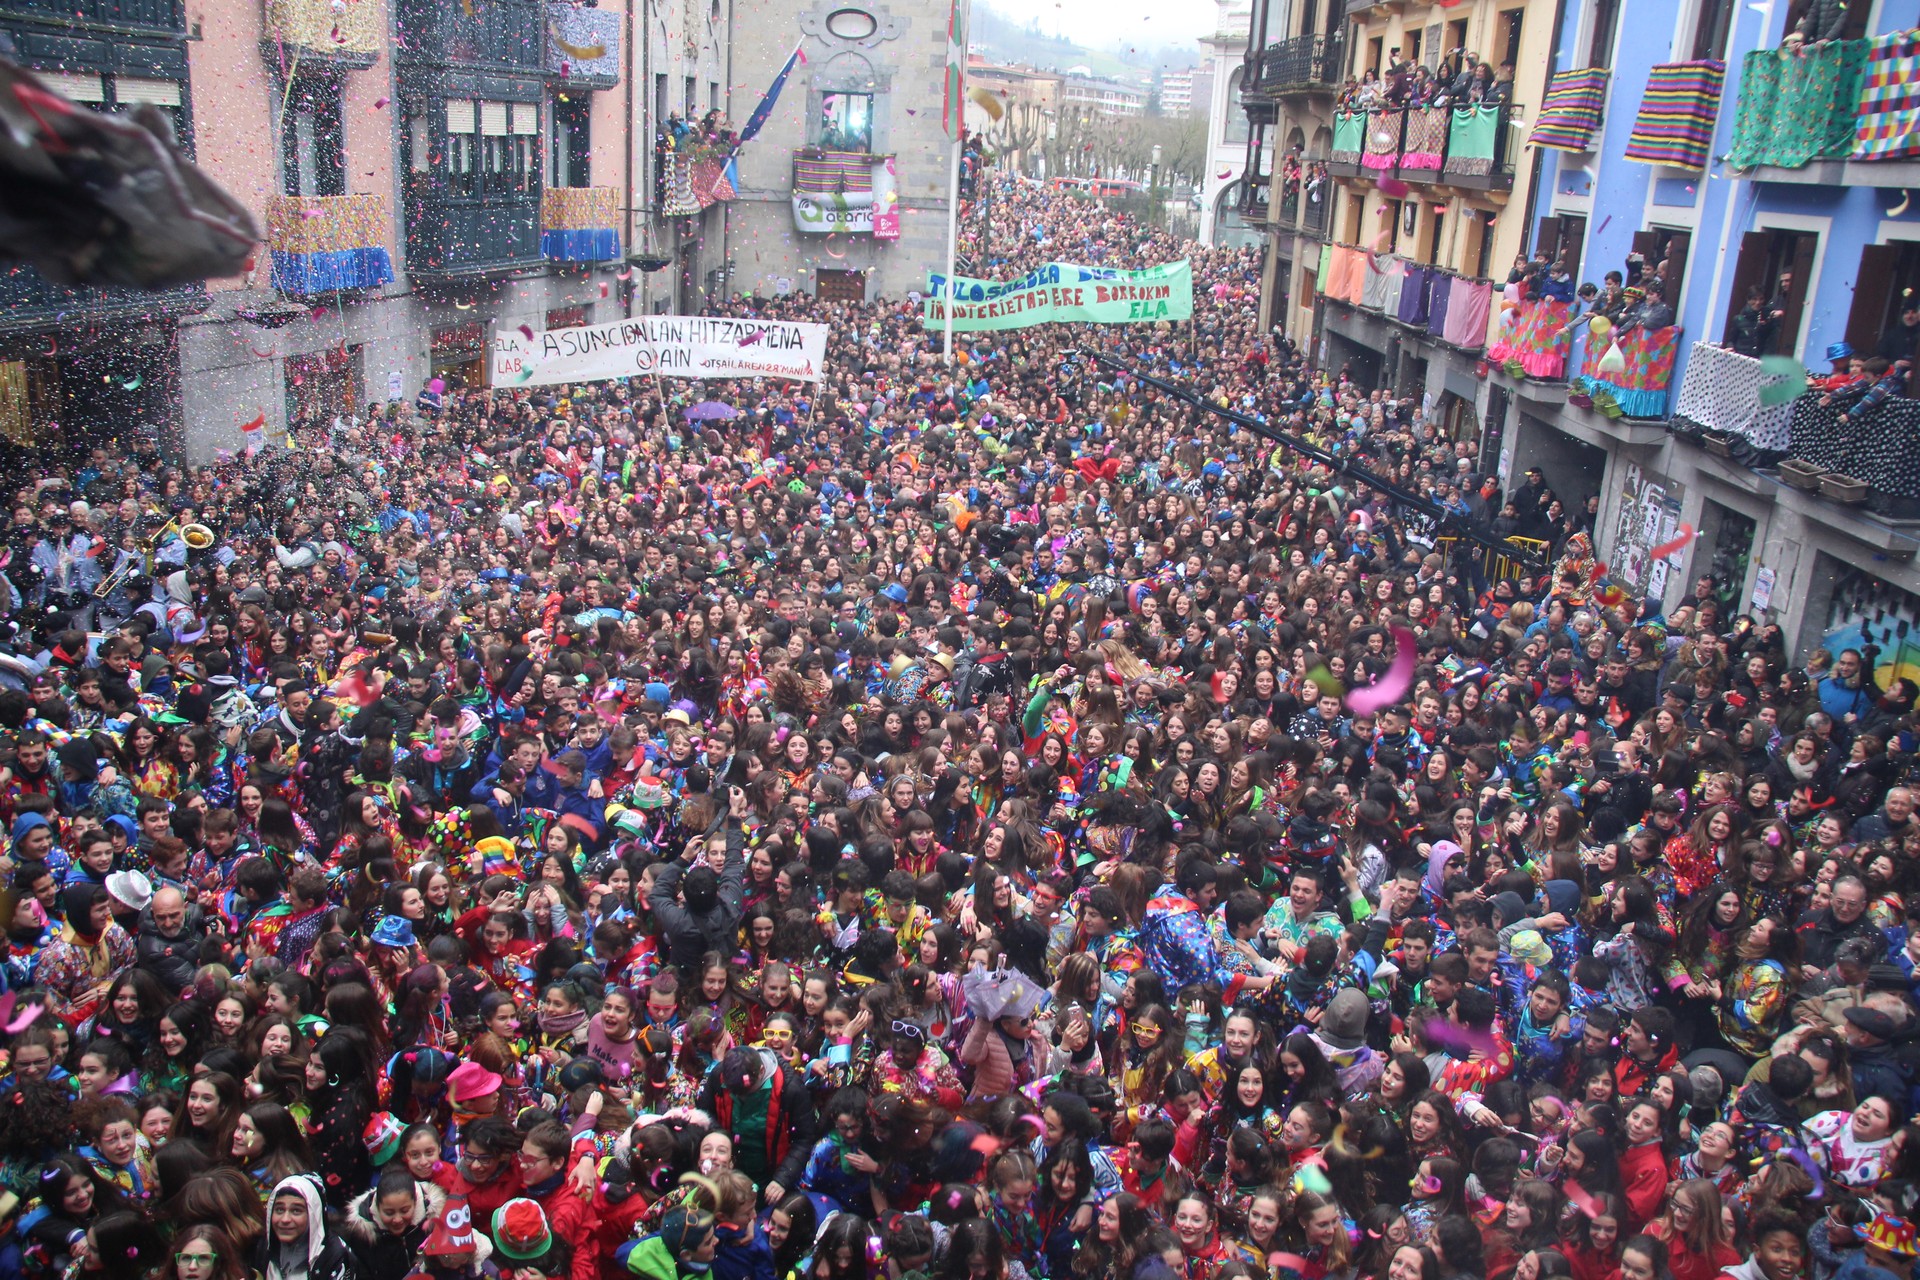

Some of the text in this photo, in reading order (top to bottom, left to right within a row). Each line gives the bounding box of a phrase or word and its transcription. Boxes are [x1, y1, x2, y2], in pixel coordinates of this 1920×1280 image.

[1051, 287, 1084, 307] ERE
[1096, 285, 1170, 304] BORROKAN
[1128, 300, 1168, 319] ELA
[650, 320, 682, 342] LAN
[689, 318, 803, 350] HITZARMENA
[495, 337, 519, 352] ELA
[497, 357, 521, 374] LAB
[592, 1044, 618, 1066] Make
